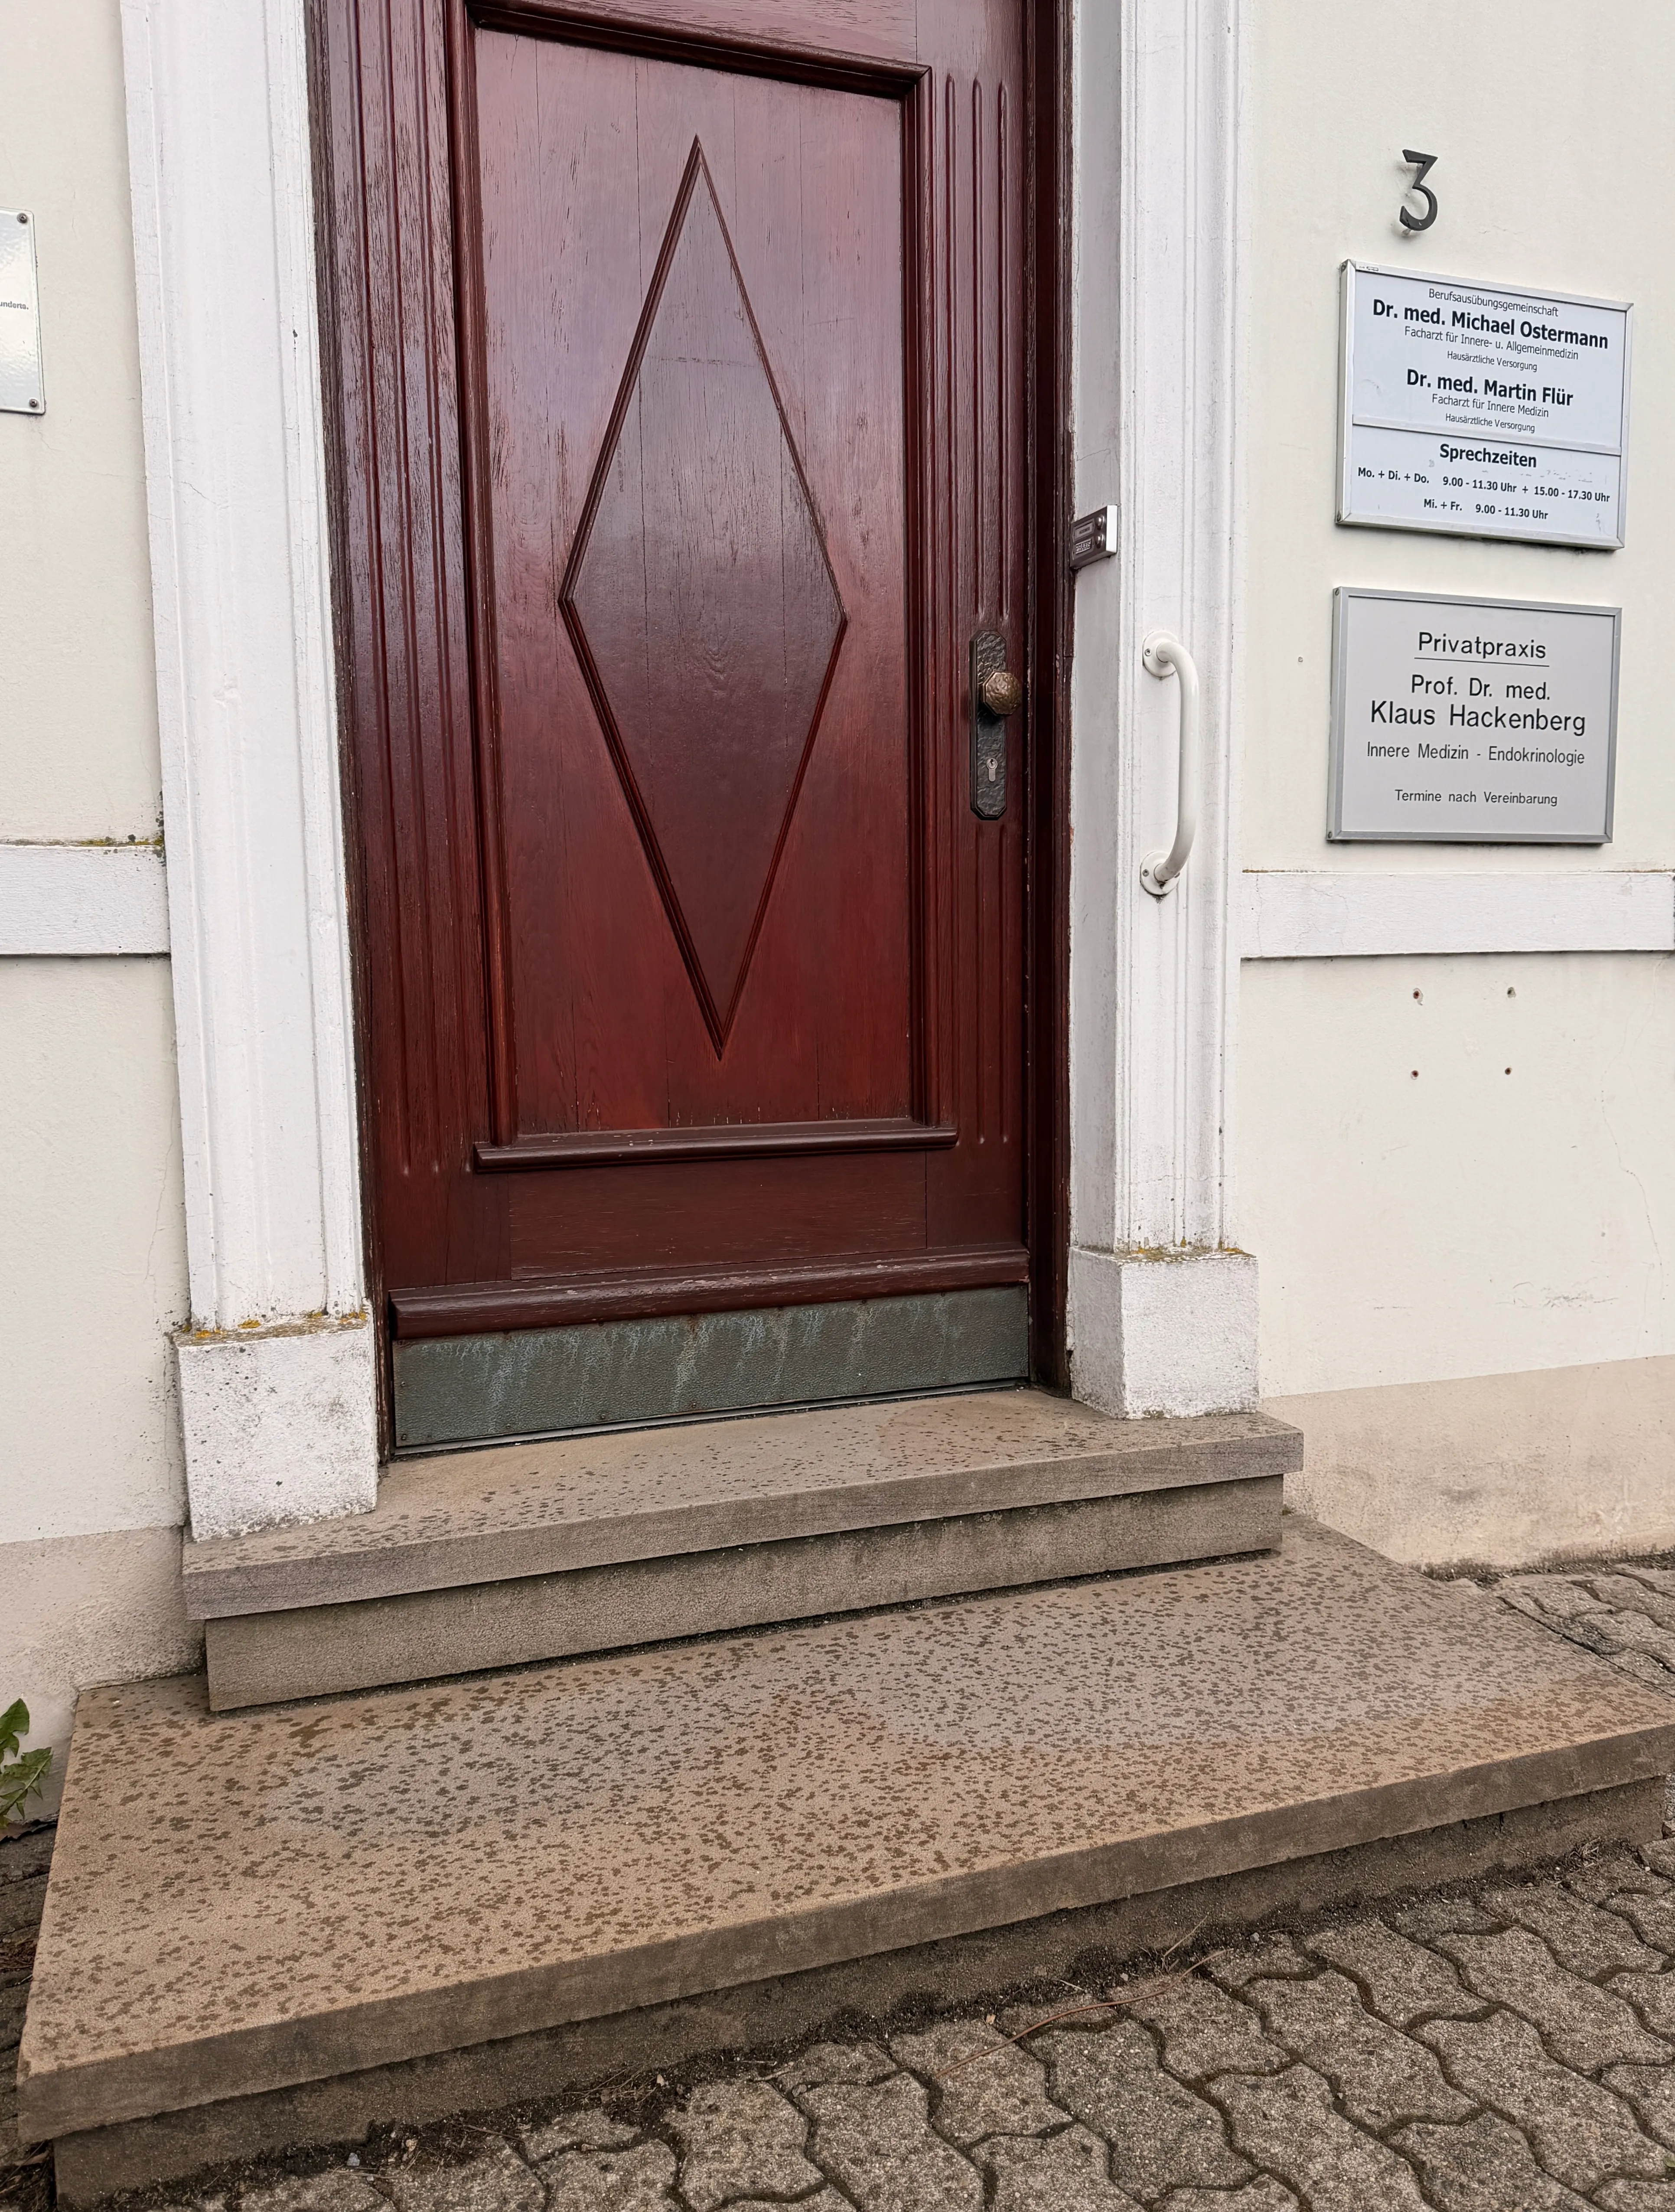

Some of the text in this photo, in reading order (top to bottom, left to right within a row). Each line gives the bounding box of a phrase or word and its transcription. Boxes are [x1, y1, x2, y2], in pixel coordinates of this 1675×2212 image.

[1399, 149, 1438, 231] 3
[1429, 288, 1559, 317] Berufsausübungsgemeinschaft
[1373, 299, 1608, 349] Dr. med. Michael Ostermann
[1405, 326, 1578, 360] Facharzt für Innere- u. Allgemeinmedizin
[1447, 350, 1537, 373] Hausärztliche Versorgung
[1407, 368, 1574, 406] Dr. med. Martin Flür
[1432, 393, 1549, 418] Facharzt für Innere Medizin
[1445, 413, 1535, 434] Hausärztliche Versorgung
[1440, 443, 1537, 468] Sprechzeiten
[1358, 467, 1375, 478] Mo.
[1378, 470, 1385, 479] +
[1388, 470, 1401, 480] Di.
[1404, 473, 1411, 481] +
[1414, 473, 1429, 484] Do.
[1443, 476, 1463, 487] 9.00
[1472, 479, 1498, 491] 11.30
[1500, 482, 1517, 493] Uhr
[1522, 486, 1528, 494] +
[1534, 486, 1559, 497] 15.00
[1567, 489, 1592, 501] 17.30
[1594, 492, 1610, 502] Uhr
[1424, 498, 1437, 509] Mi.
[1440, 501, 1447, 509] +
[1450, 501, 1462, 511] Fr.
[1475, 503, 1496, 515] 9.00
[1504, 506, 1530, 518] 11.30
[1532, 509, 1549, 520] Uhr
[1418, 631, 1546, 659] Privatpraxis
[1411, 674, 1550, 700] Prof. Dr. med.
[1371, 700, 1585, 737] Klaus Hackenberg
[1367, 741, 1410, 758] Innere
[1418, 743, 1469, 760] Medizin
[1489, 745, 1585, 767] Endokrinologie
[1395, 789, 1558, 807] Termine nach Vereinbarung
